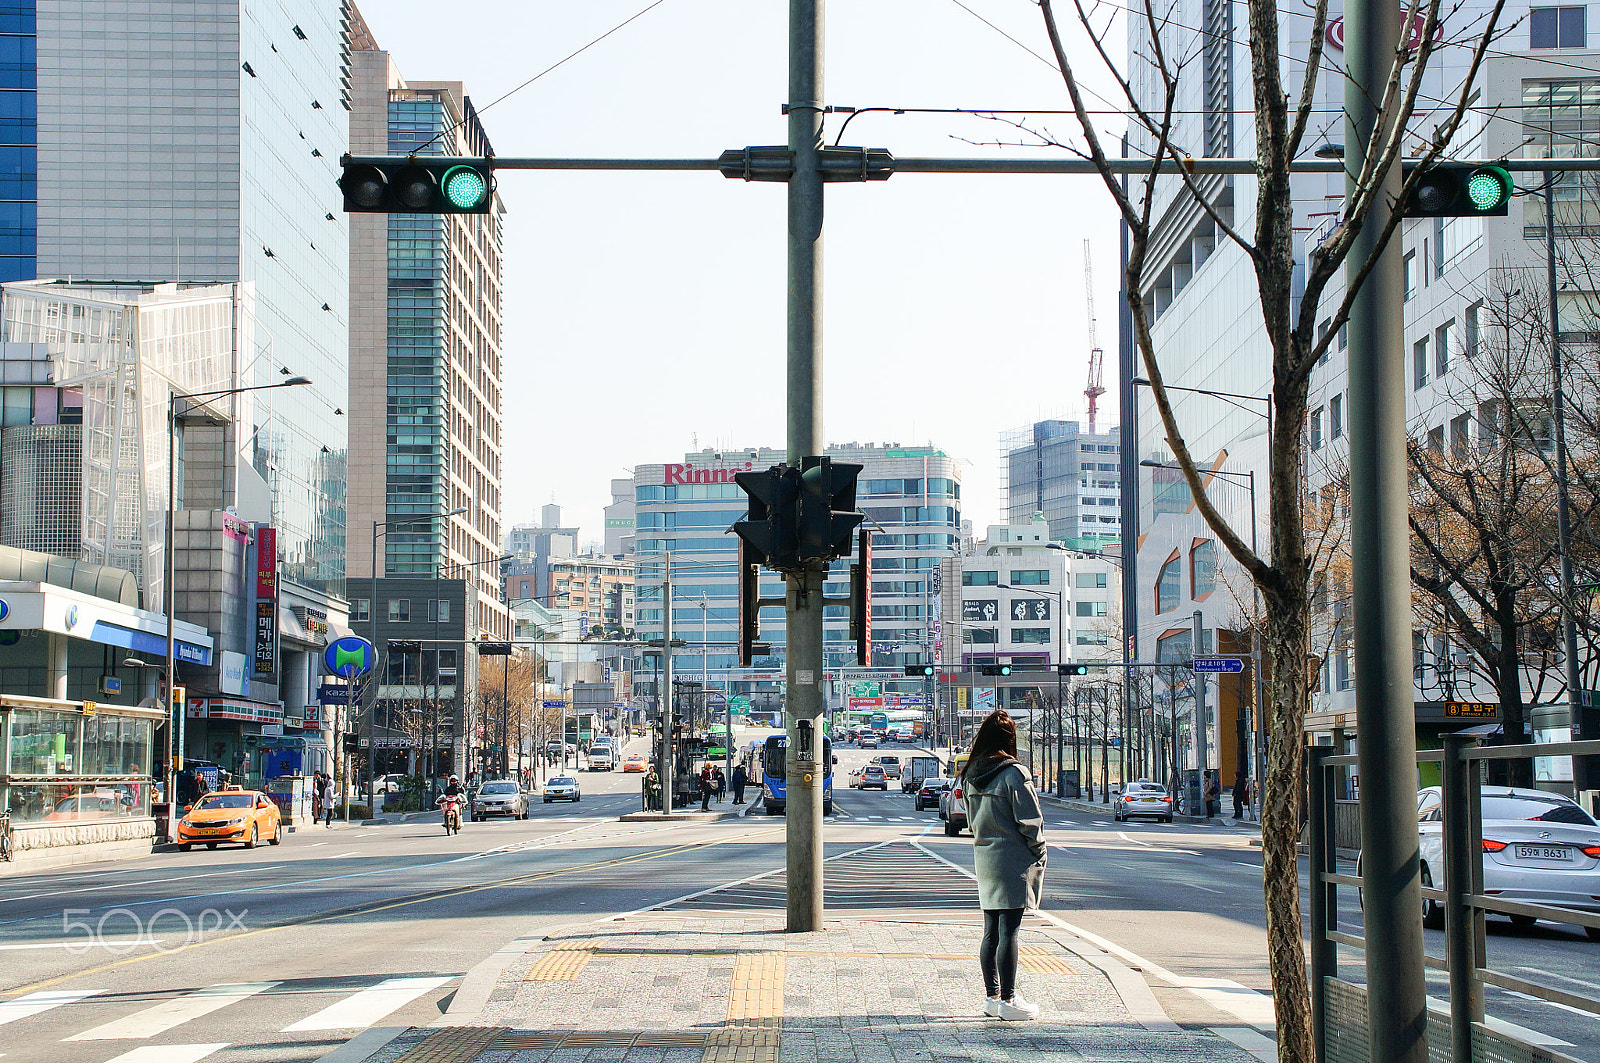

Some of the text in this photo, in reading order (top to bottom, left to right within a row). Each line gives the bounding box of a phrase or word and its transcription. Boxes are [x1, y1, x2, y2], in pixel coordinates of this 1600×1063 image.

[940, 674, 958, 682] K2
[1450, 705, 1457, 714] 8
[1461, 704, 1495, 713] 출입구
[1543, 848, 1567, 859] 8631
